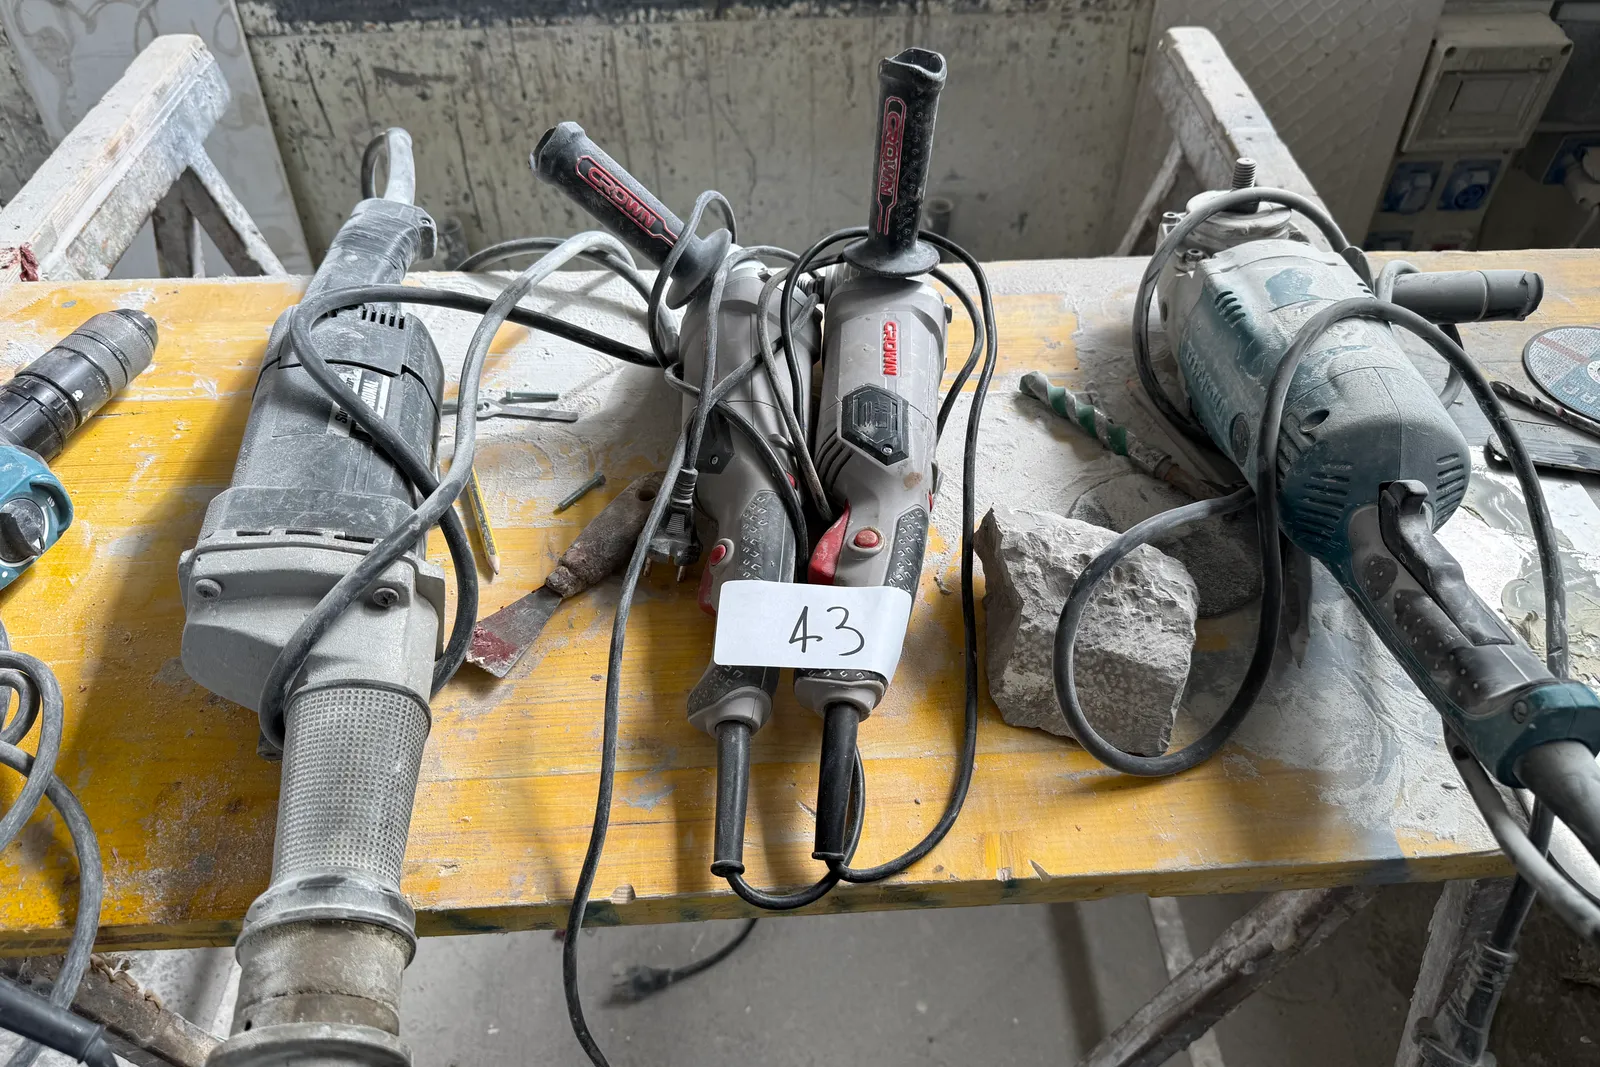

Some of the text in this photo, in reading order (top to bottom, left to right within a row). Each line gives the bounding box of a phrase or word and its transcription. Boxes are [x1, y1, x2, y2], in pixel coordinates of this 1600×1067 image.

[880, 111, 900, 196] CROWN
[588, 167, 656, 228] CROWN
[883, 321, 898, 376] CROWN
[788, 605, 864, 656] 43
